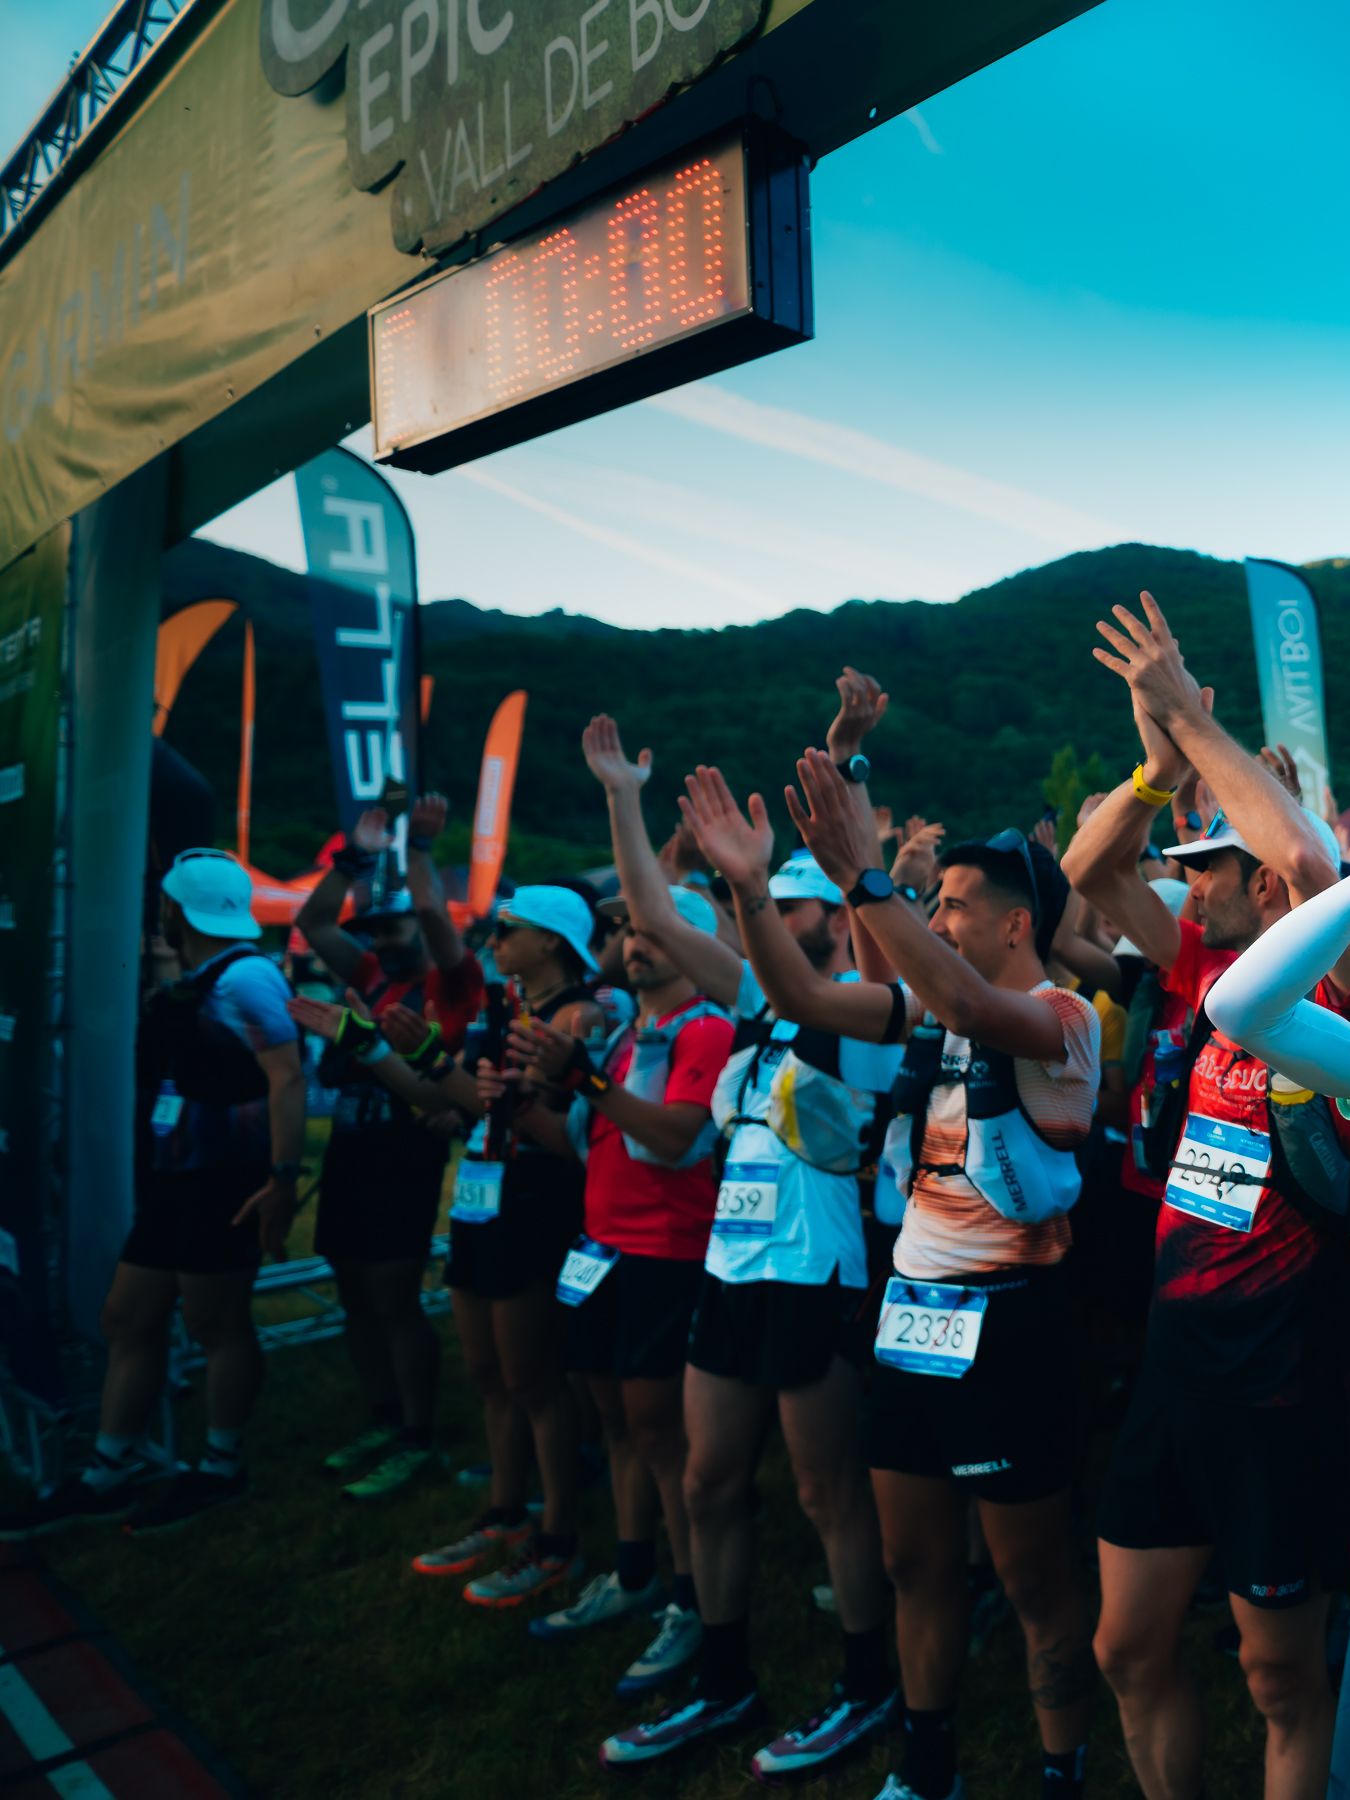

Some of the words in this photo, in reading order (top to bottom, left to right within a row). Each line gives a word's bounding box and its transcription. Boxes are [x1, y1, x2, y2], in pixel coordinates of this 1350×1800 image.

[359, 0, 514, 155] EPIC
[419, 80, 533, 222] VALL
[544, 6, 614, 138] DE
[991, 1130, 1029, 1212] MERRELL
[896, 1311, 965, 1349] 2338
